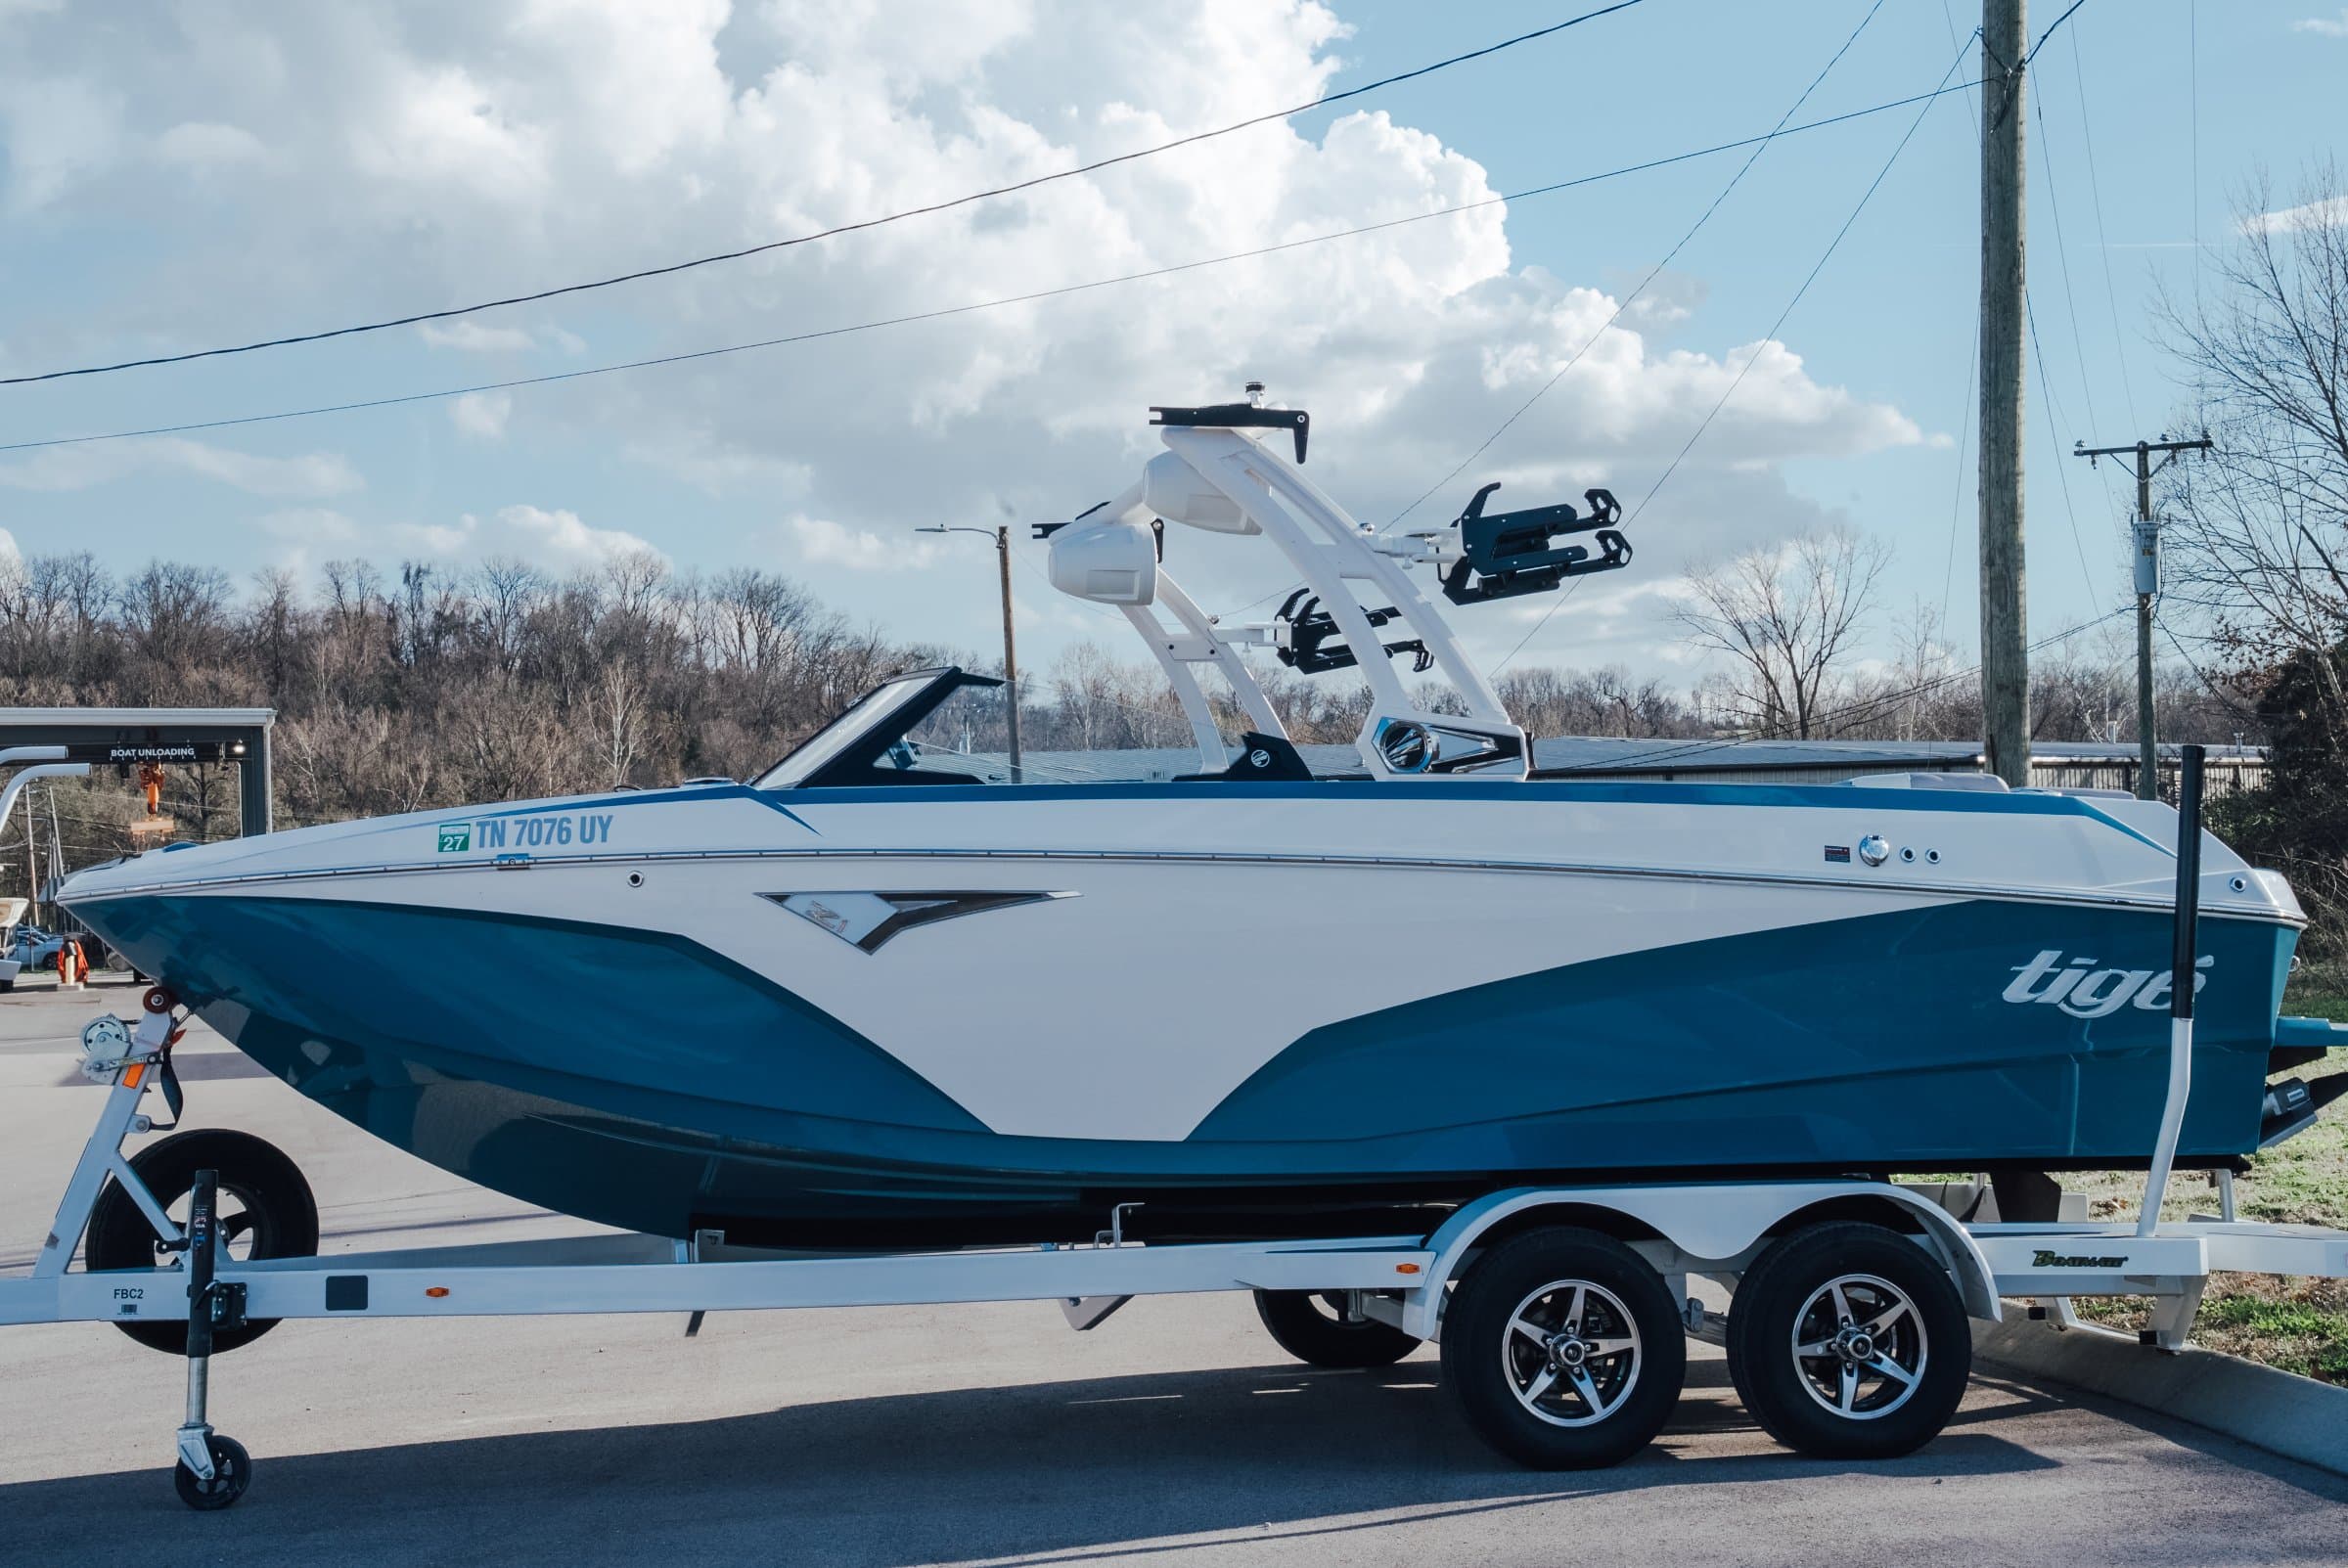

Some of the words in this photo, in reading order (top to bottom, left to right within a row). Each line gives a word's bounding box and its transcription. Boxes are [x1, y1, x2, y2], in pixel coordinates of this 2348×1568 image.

[138, 747, 195, 756] UNLOADING
[475, 819, 507, 849] TN
[514, 816, 572, 847] 7076
[579, 814, 613, 844] UY
[443, 836, 465, 851] 27
[113, 1288, 145, 1300] FBC2
